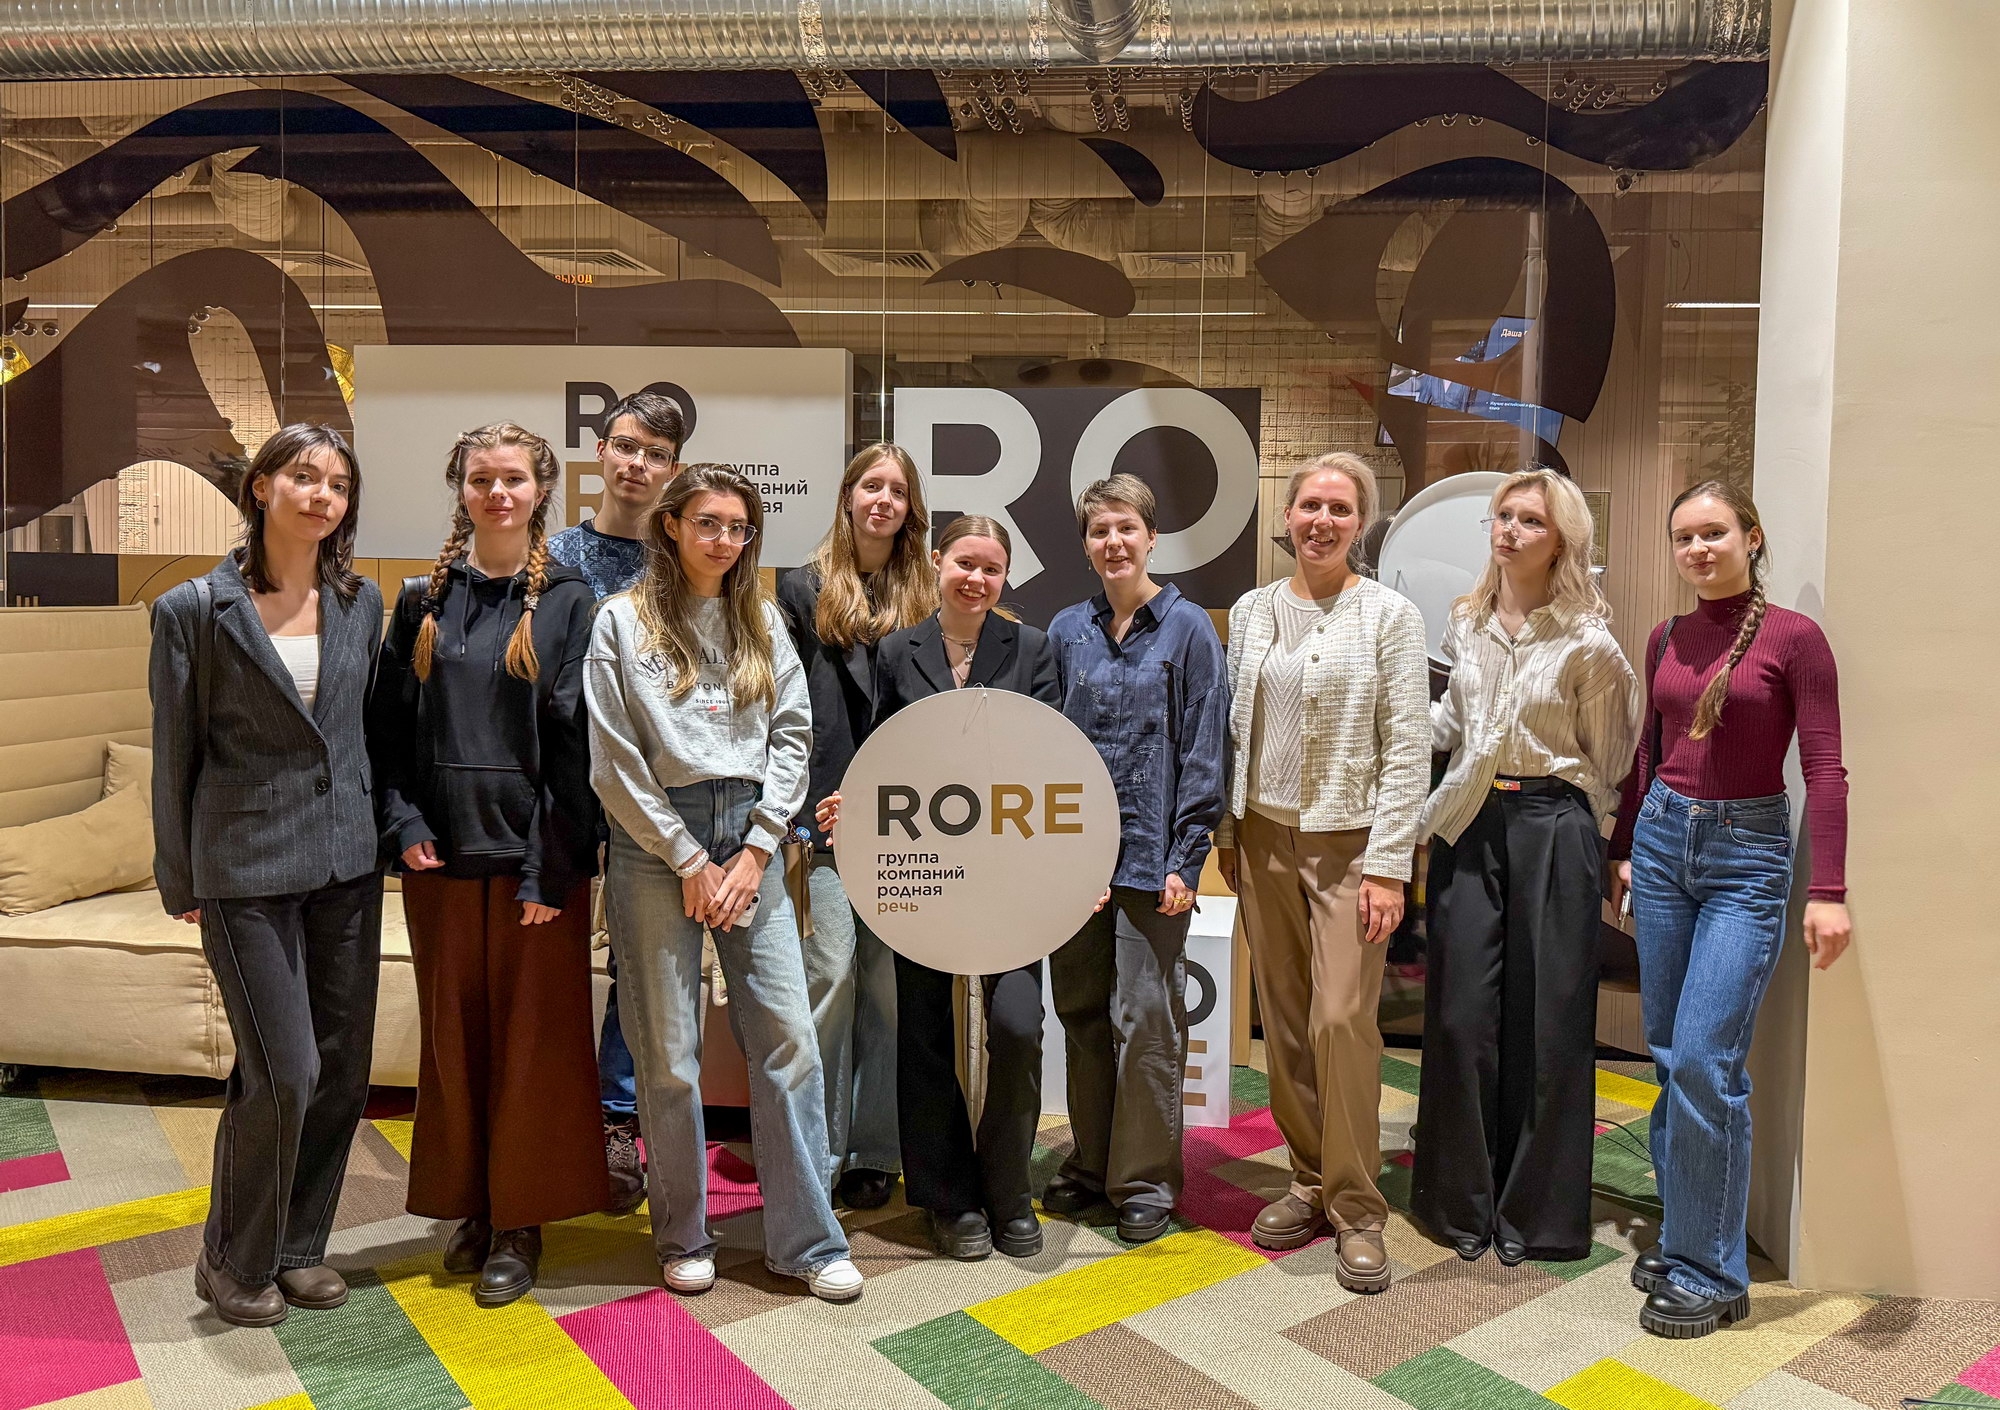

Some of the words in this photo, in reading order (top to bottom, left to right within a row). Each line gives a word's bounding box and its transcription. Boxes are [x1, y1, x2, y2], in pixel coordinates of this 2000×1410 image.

[1501, 329, 1522, 338] Даша
[894, 388, 1259, 590] RO
[878, 783, 1083, 841] RORE
[877, 852, 939, 867] группа
[877, 865, 965, 881] компаний
[877, 884, 943, 899] родная
[877, 901, 919, 915] речь
